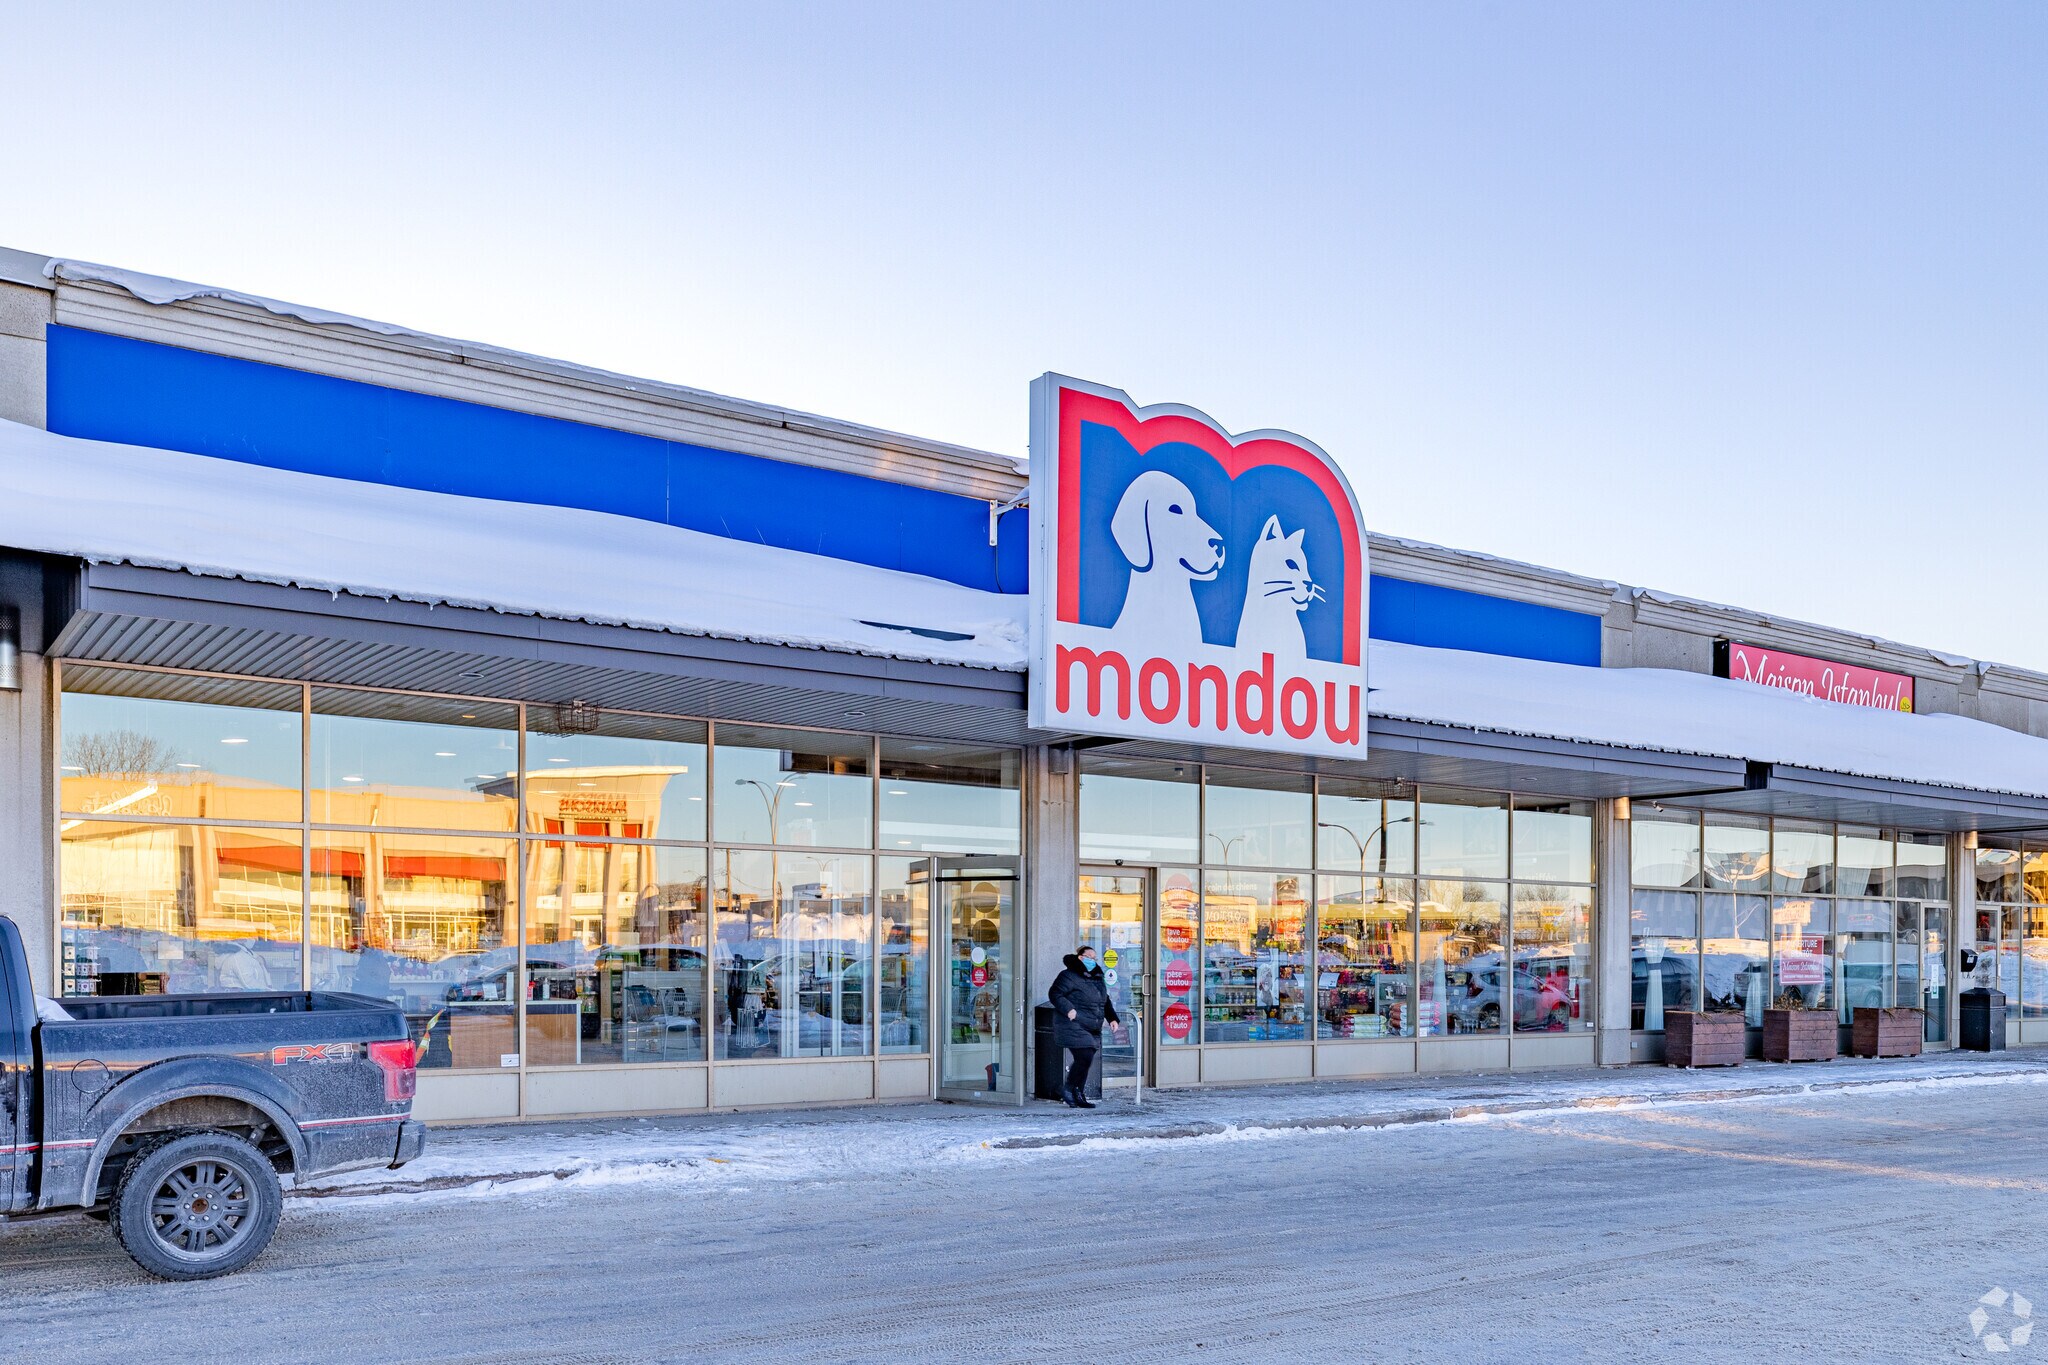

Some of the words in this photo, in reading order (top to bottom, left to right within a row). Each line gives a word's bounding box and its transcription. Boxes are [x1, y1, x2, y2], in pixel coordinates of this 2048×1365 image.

[1055, 643, 1361, 747] mondou
[1166, 978, 1189, 986] toutou
[1166, 1013, 1189, 1021] service
[272, 1043, 354, 1066] FX4
